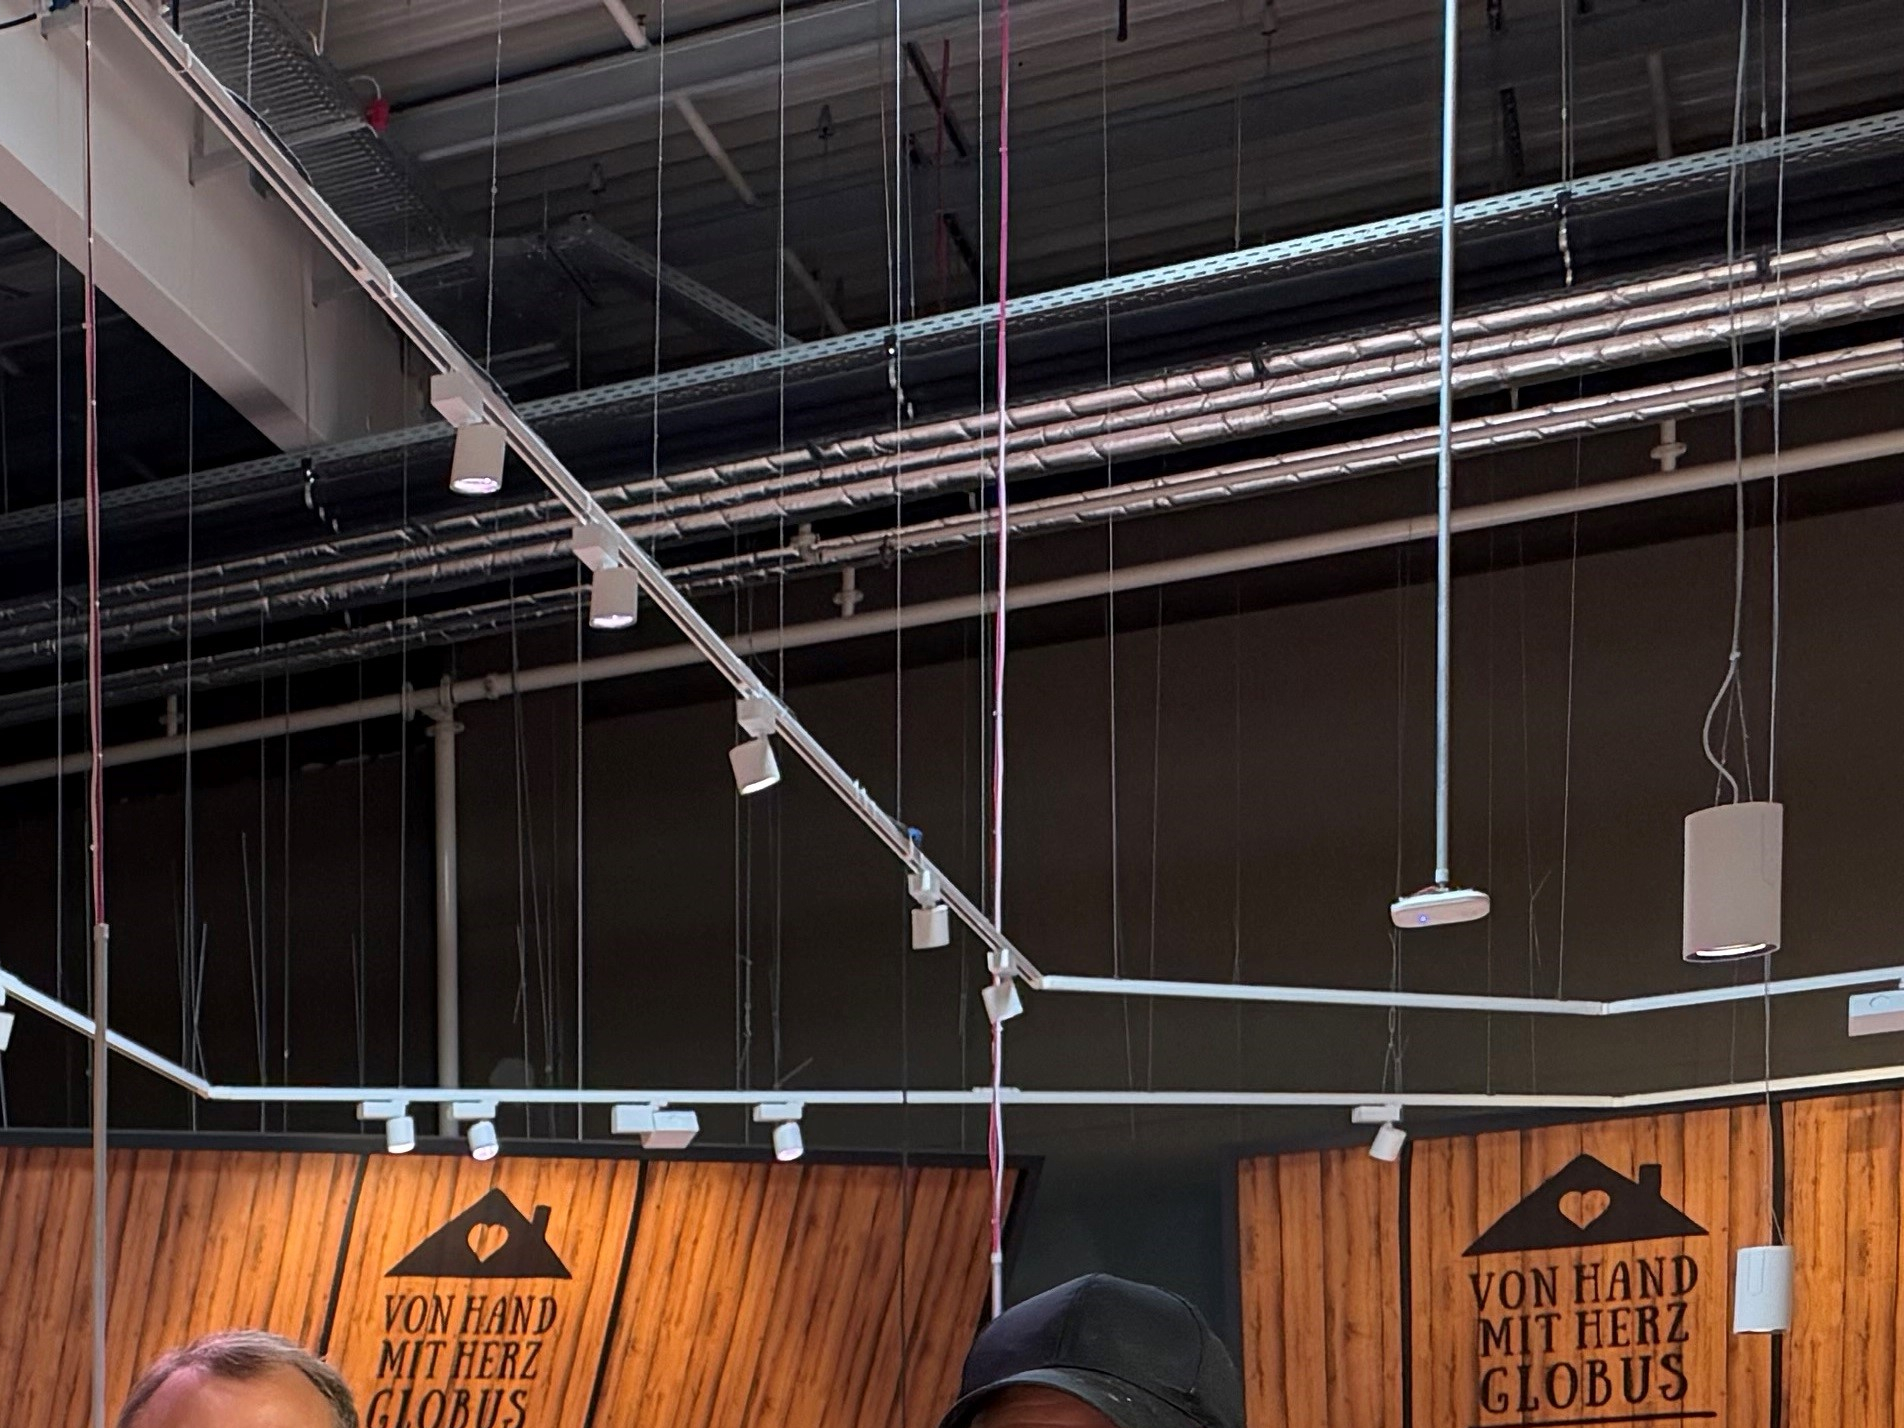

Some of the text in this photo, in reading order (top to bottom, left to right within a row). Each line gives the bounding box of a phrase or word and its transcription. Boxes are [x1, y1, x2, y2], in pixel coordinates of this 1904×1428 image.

[1469, 1254, 1698, 1311] VON HAND
[384, 1294, 557, 1335] VON HAND
[1478, 1301, 1689, 1357] MIT HERZ
[376, 1341, 542, 1380] MIT HERZ
[1481, 1353, 1688, 1414] GLOBUS
